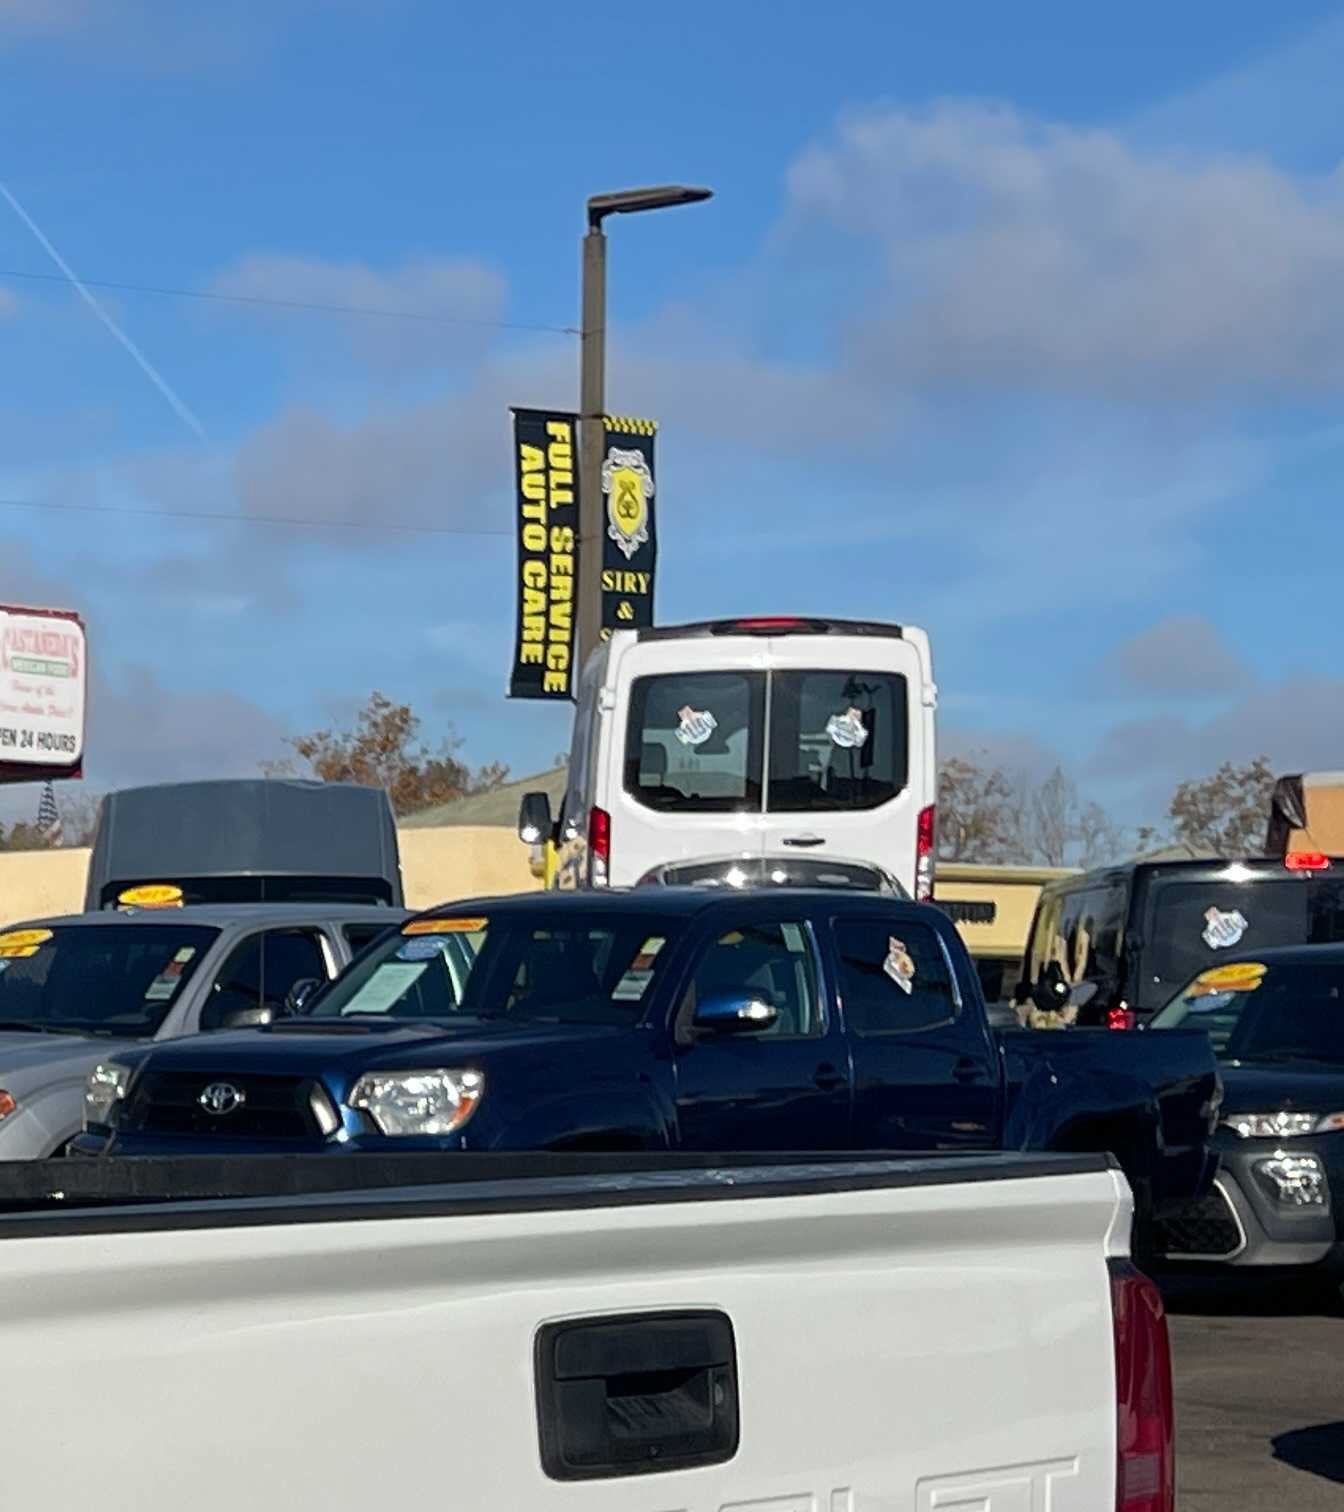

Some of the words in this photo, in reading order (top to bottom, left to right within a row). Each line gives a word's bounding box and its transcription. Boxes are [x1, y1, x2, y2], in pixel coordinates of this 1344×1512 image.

[521, 443, 547, 552] AUTO
[546, 421, 573, 508] FULL
[520, 560, 547, 663] CARE
[543, 526, 573, 692] SERVICE
[601, 570, 650, 594] SIRY
[617, 601, 634, 620] &
[20, 729, 33, 748] 24
[37, 732, 75, 752] HOURS
